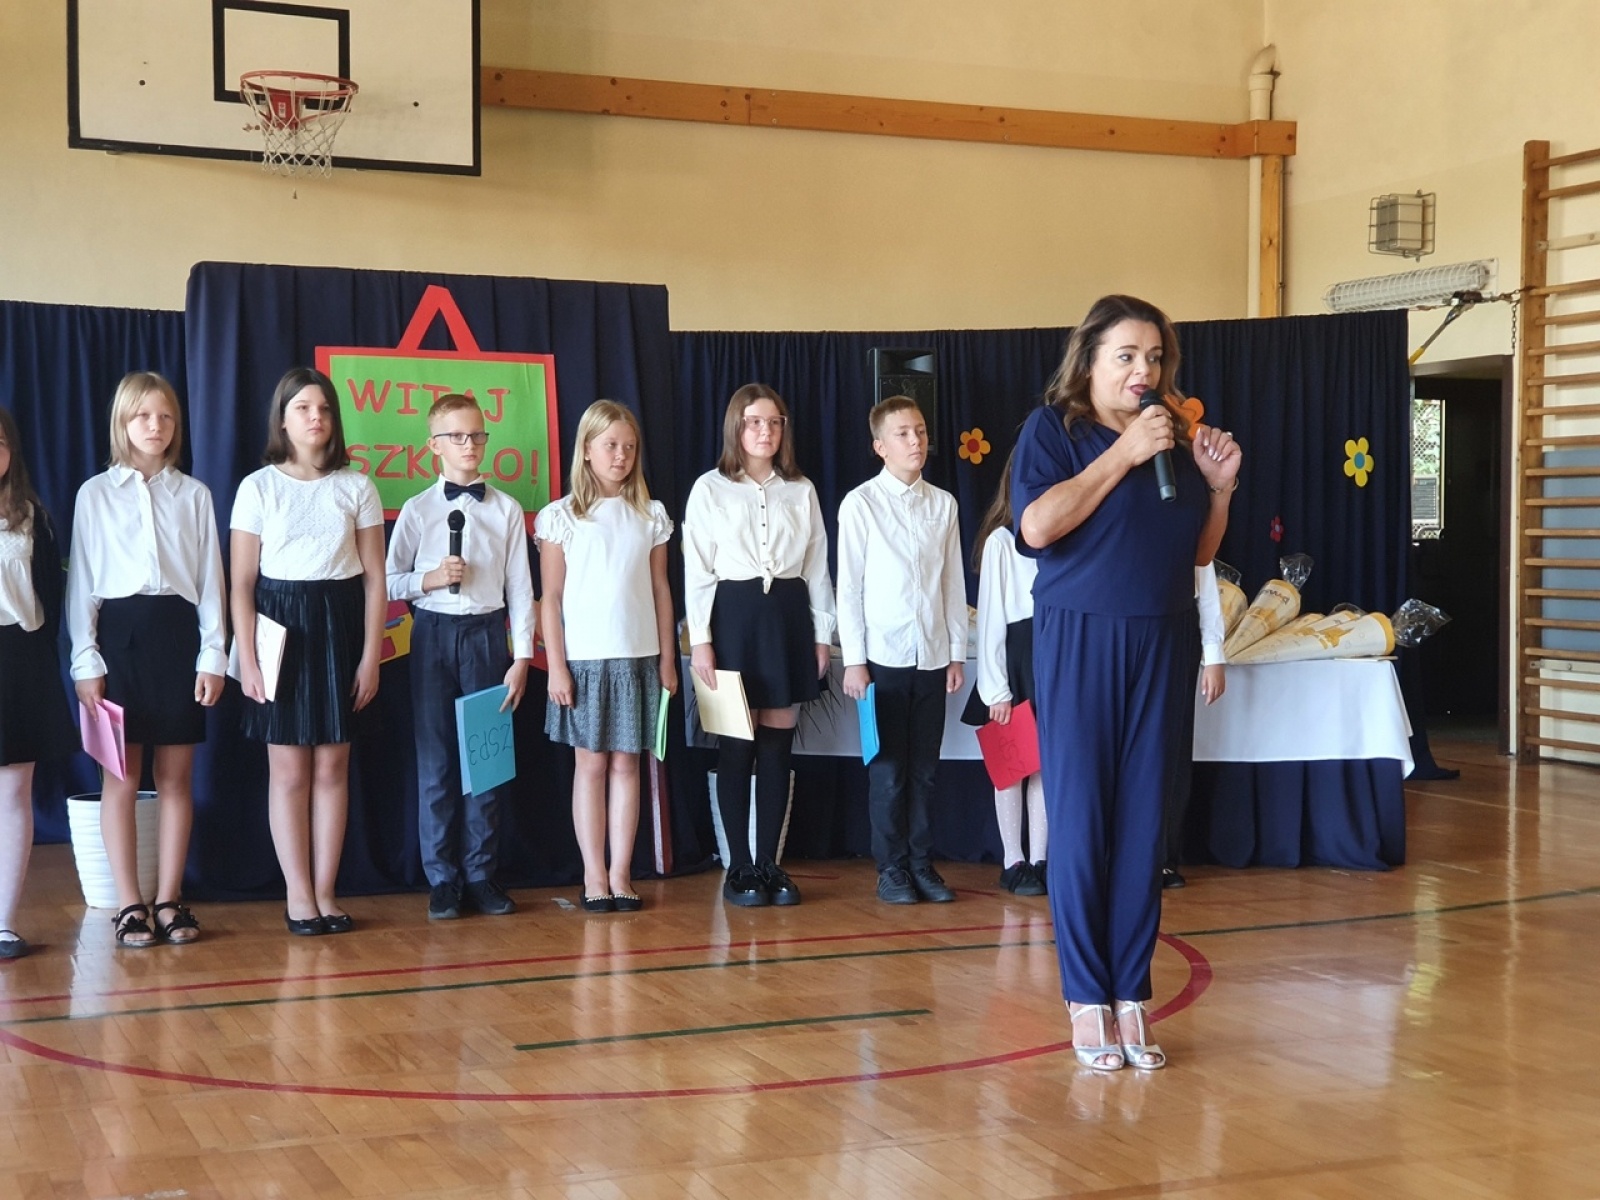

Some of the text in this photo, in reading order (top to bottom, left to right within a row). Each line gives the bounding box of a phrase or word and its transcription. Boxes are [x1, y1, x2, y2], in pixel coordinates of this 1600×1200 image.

[346, 378, 511, 423] WITJ
[346, 444, 539, 485] SZKO!
[467, 723, 513, 766] ZSP3
